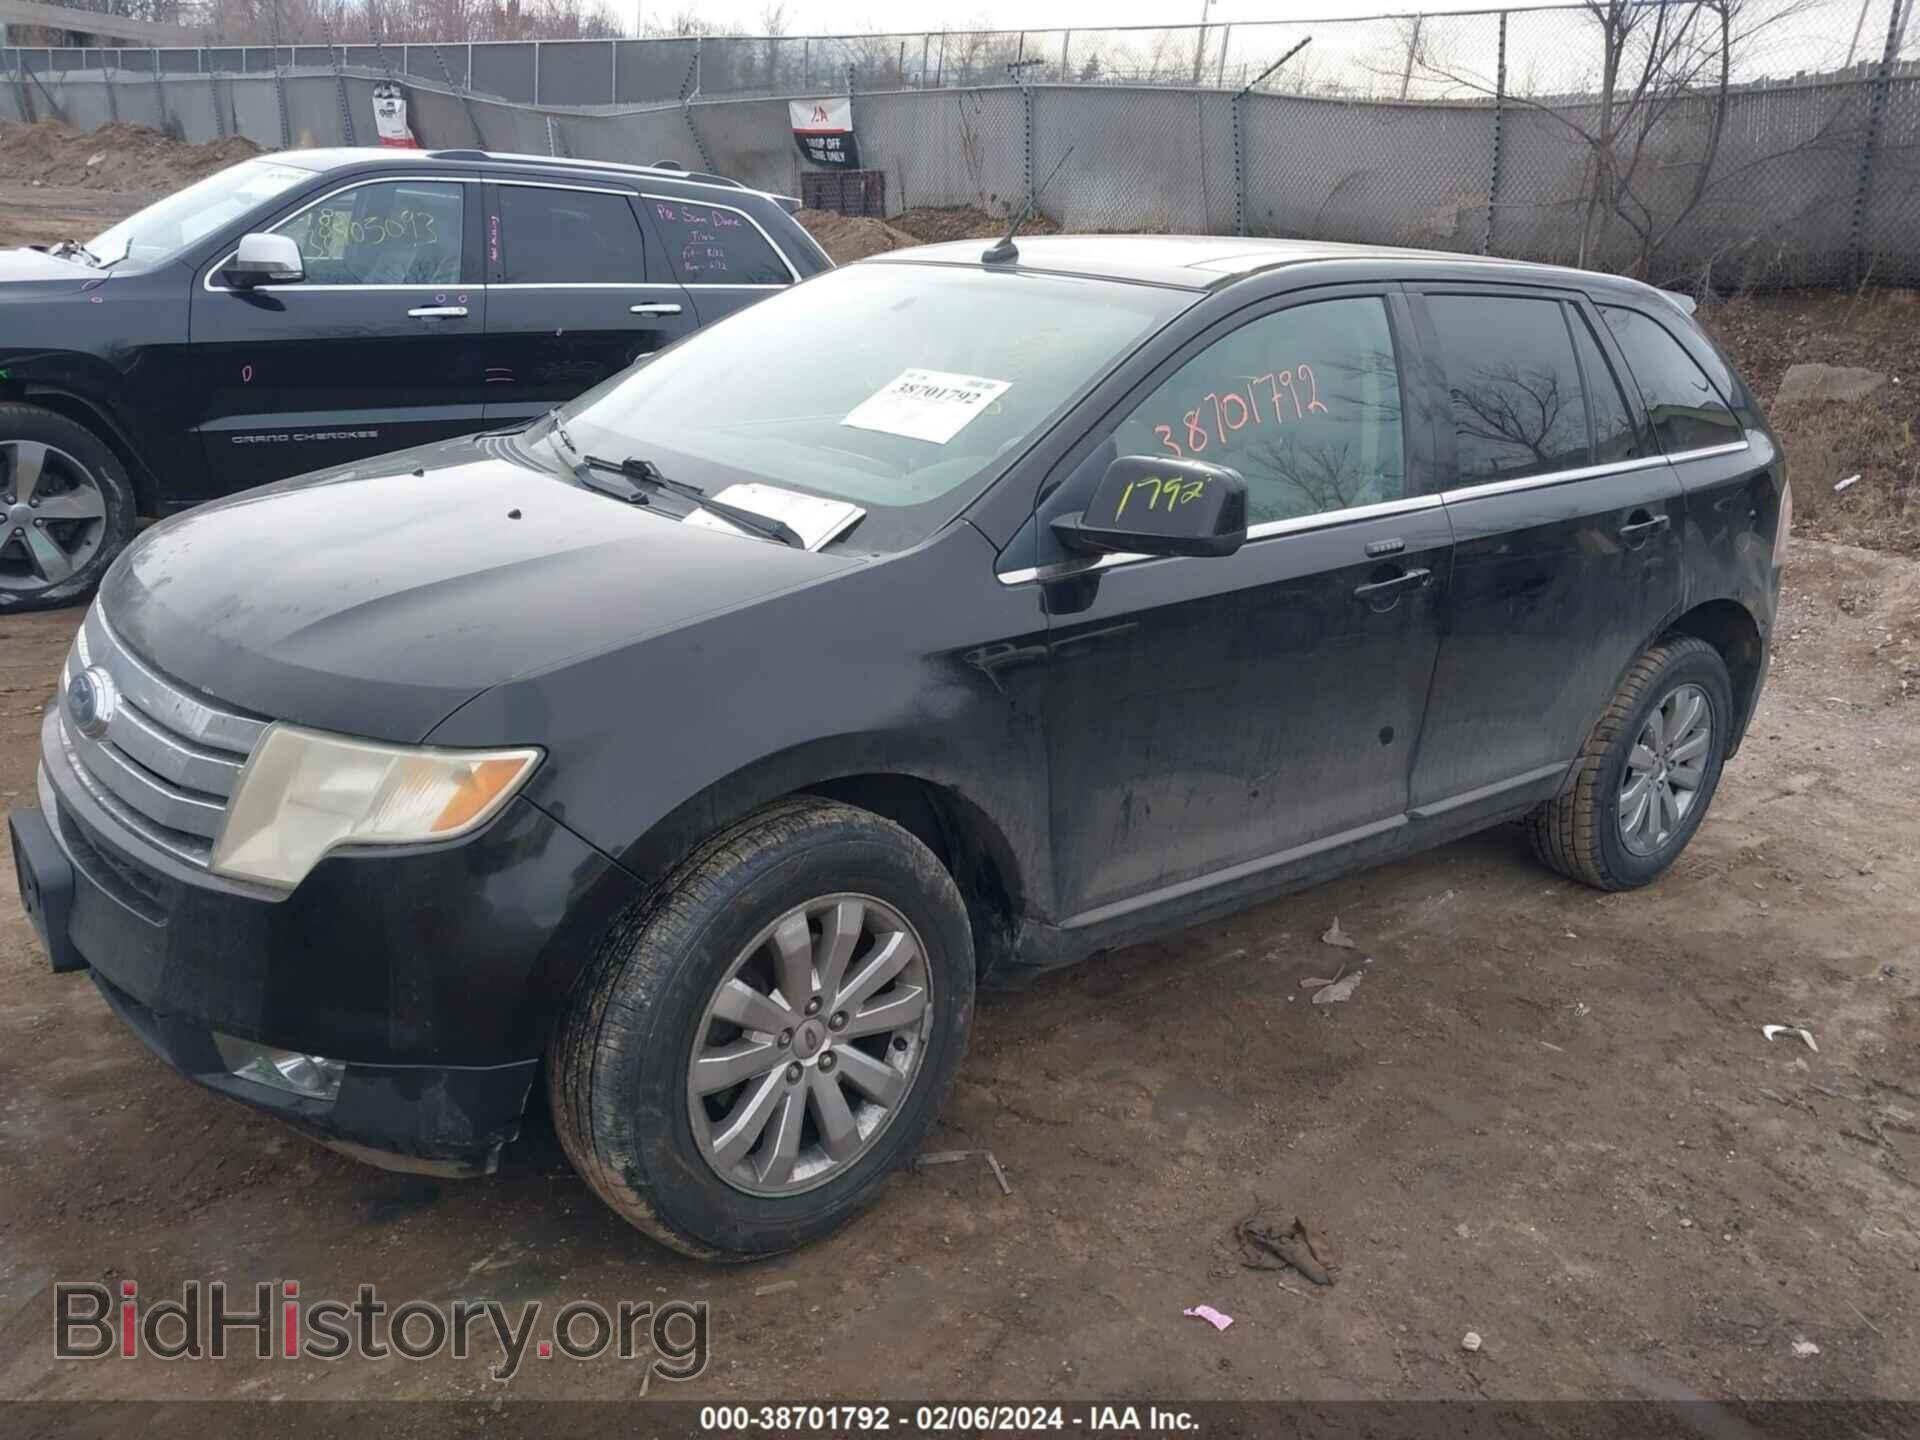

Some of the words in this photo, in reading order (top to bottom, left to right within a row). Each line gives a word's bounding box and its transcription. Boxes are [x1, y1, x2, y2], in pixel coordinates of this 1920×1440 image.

[826, 137, 841, 150] OFF
[892, 382, 982, 405] 38701792
[1154, 364, 1330, 458] 38701792
[231, 434, 289, 444] GRAND
[292, 430, 379, 442] CHEROKEE
[1114, 476, 1205, 524] 1792
